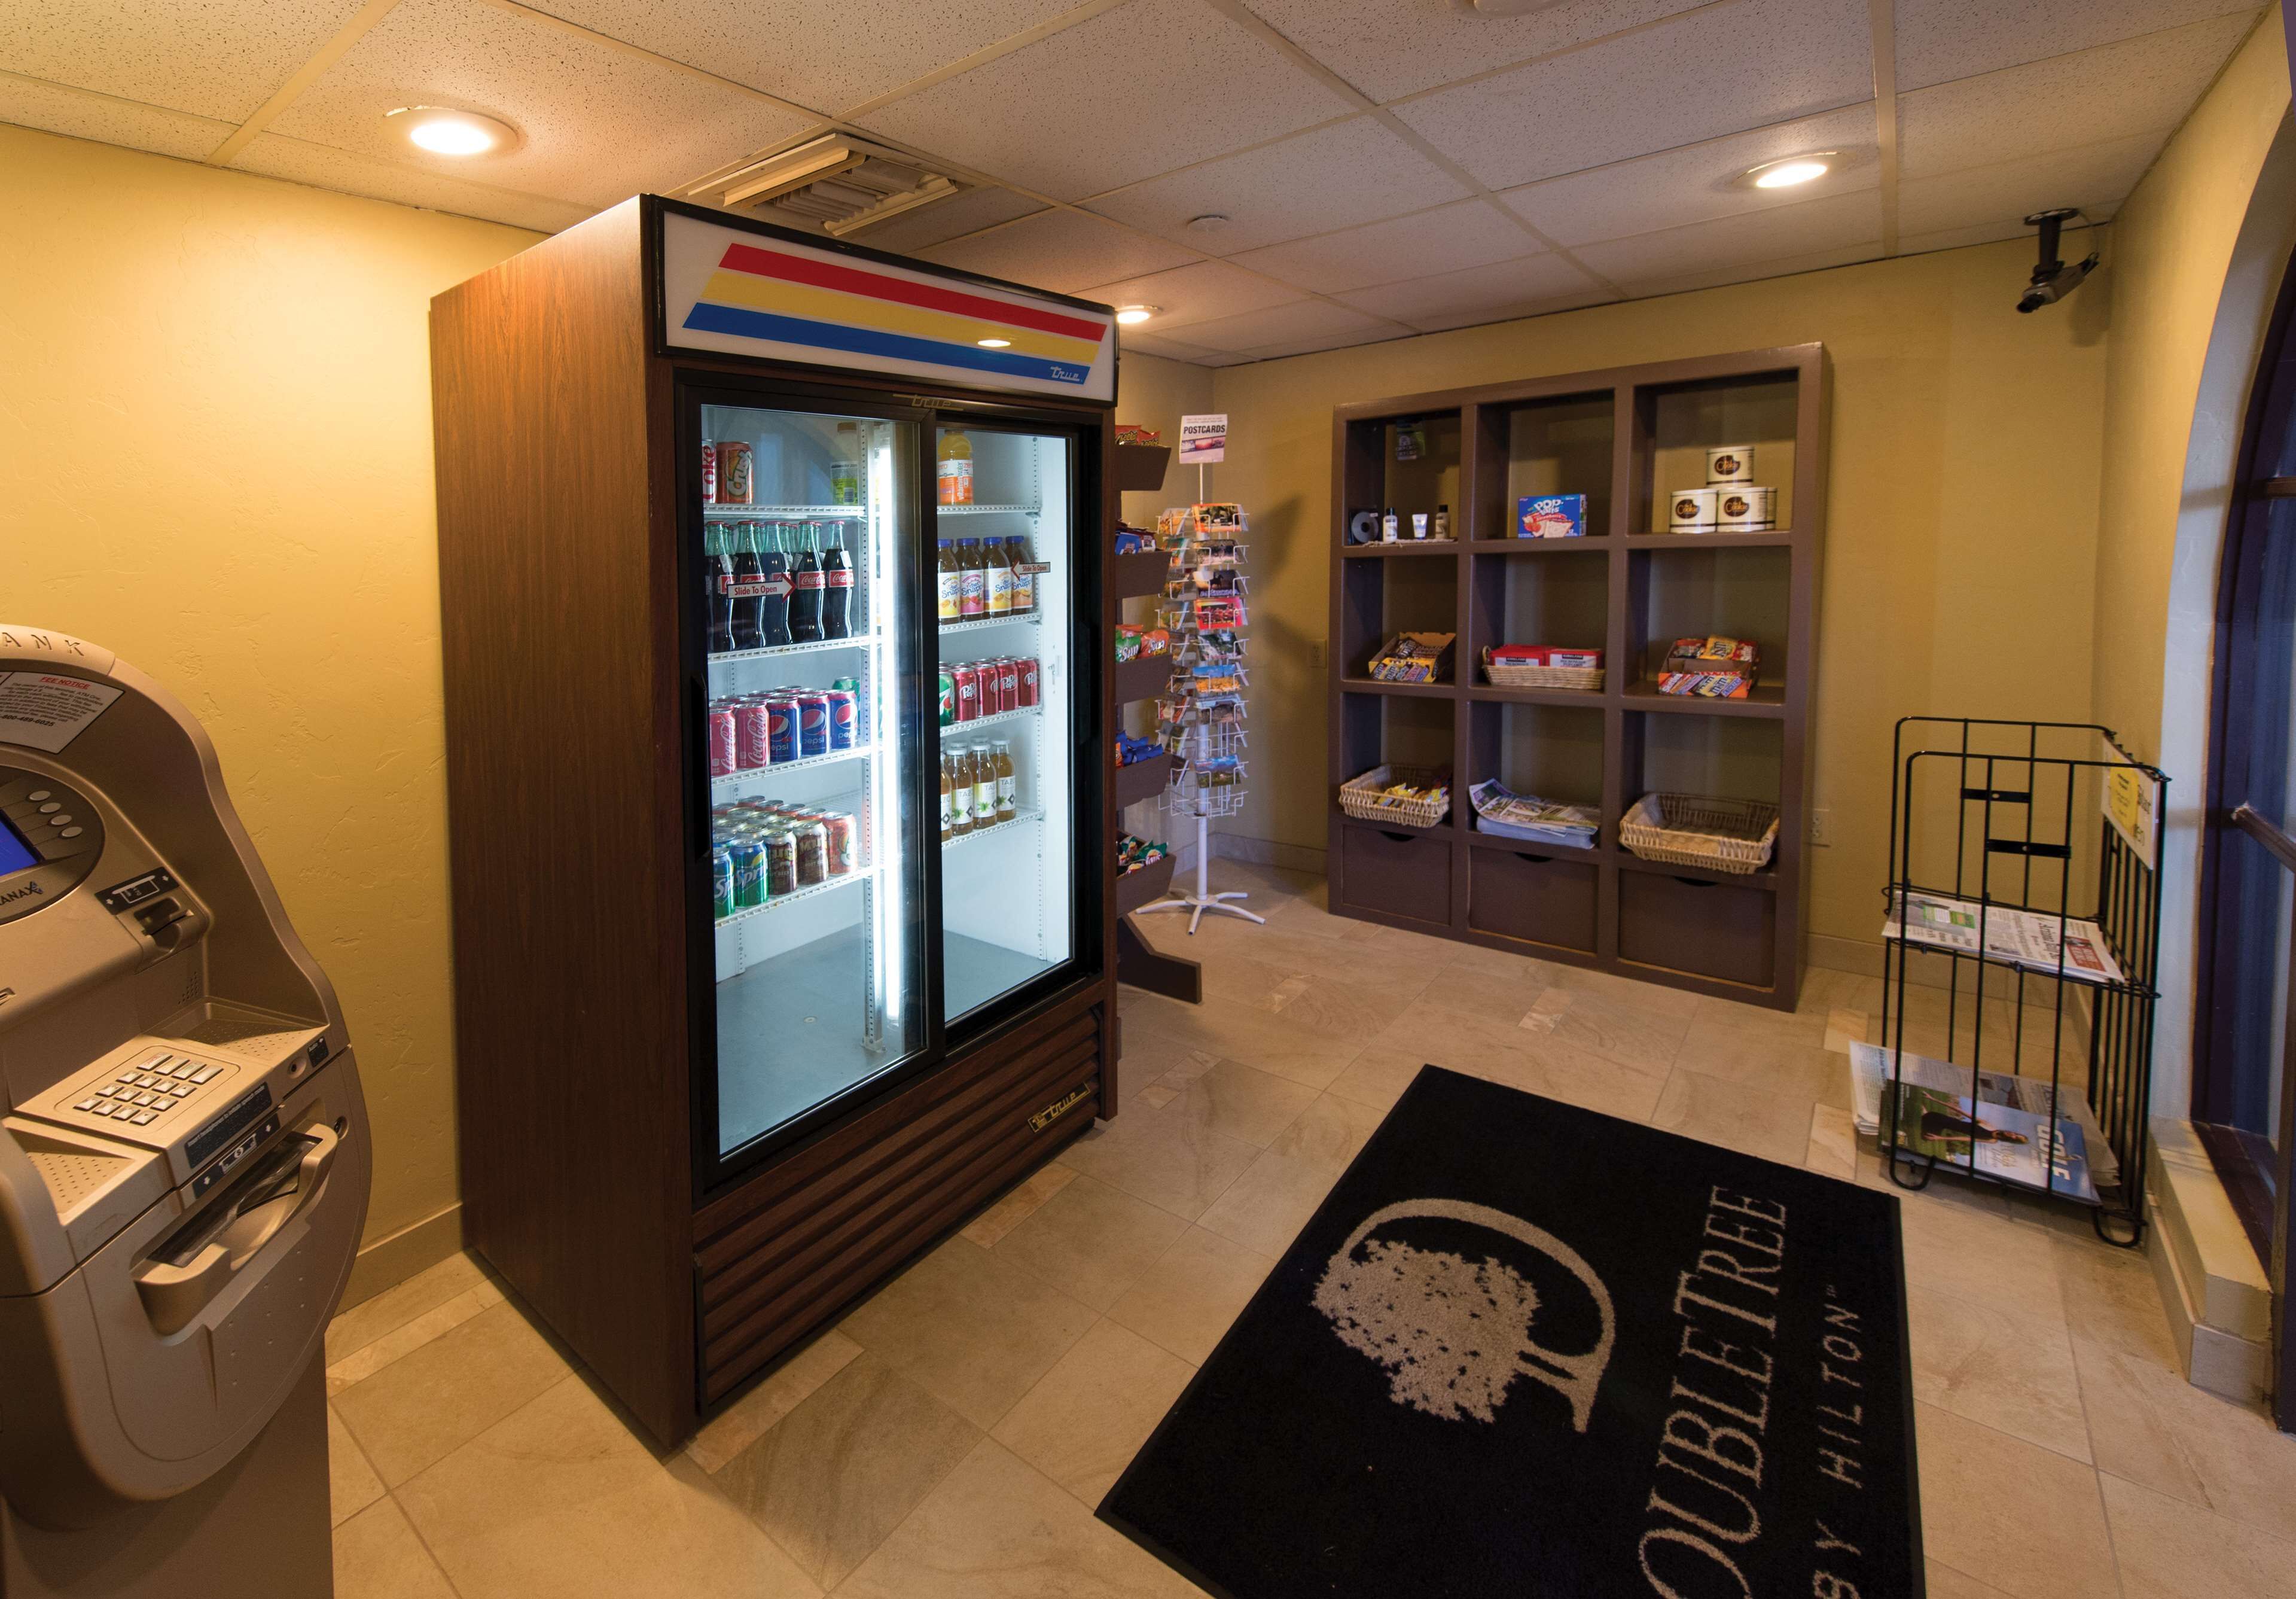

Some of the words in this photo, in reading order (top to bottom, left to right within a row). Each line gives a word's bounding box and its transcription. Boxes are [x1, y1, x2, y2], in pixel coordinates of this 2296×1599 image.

[1050, 366, 1080, 381] true
[1184, 425, 1225, 434] POSTCARDS
[734, 586, 751, 596] Slide
[752, 586, 760, 594] To
[761, 585, 777, 595] Open
[1120, 644, 1139, 662] Sun
[59, 678, 91, 690] NOTICE
[748, 708, 767, 766] Coca-Cola
[771, 744, 789, 752] epsi
[2036, 1124, 2071, 1181] GOLF
[1816, 1302, 1863, 1490] HILTON
